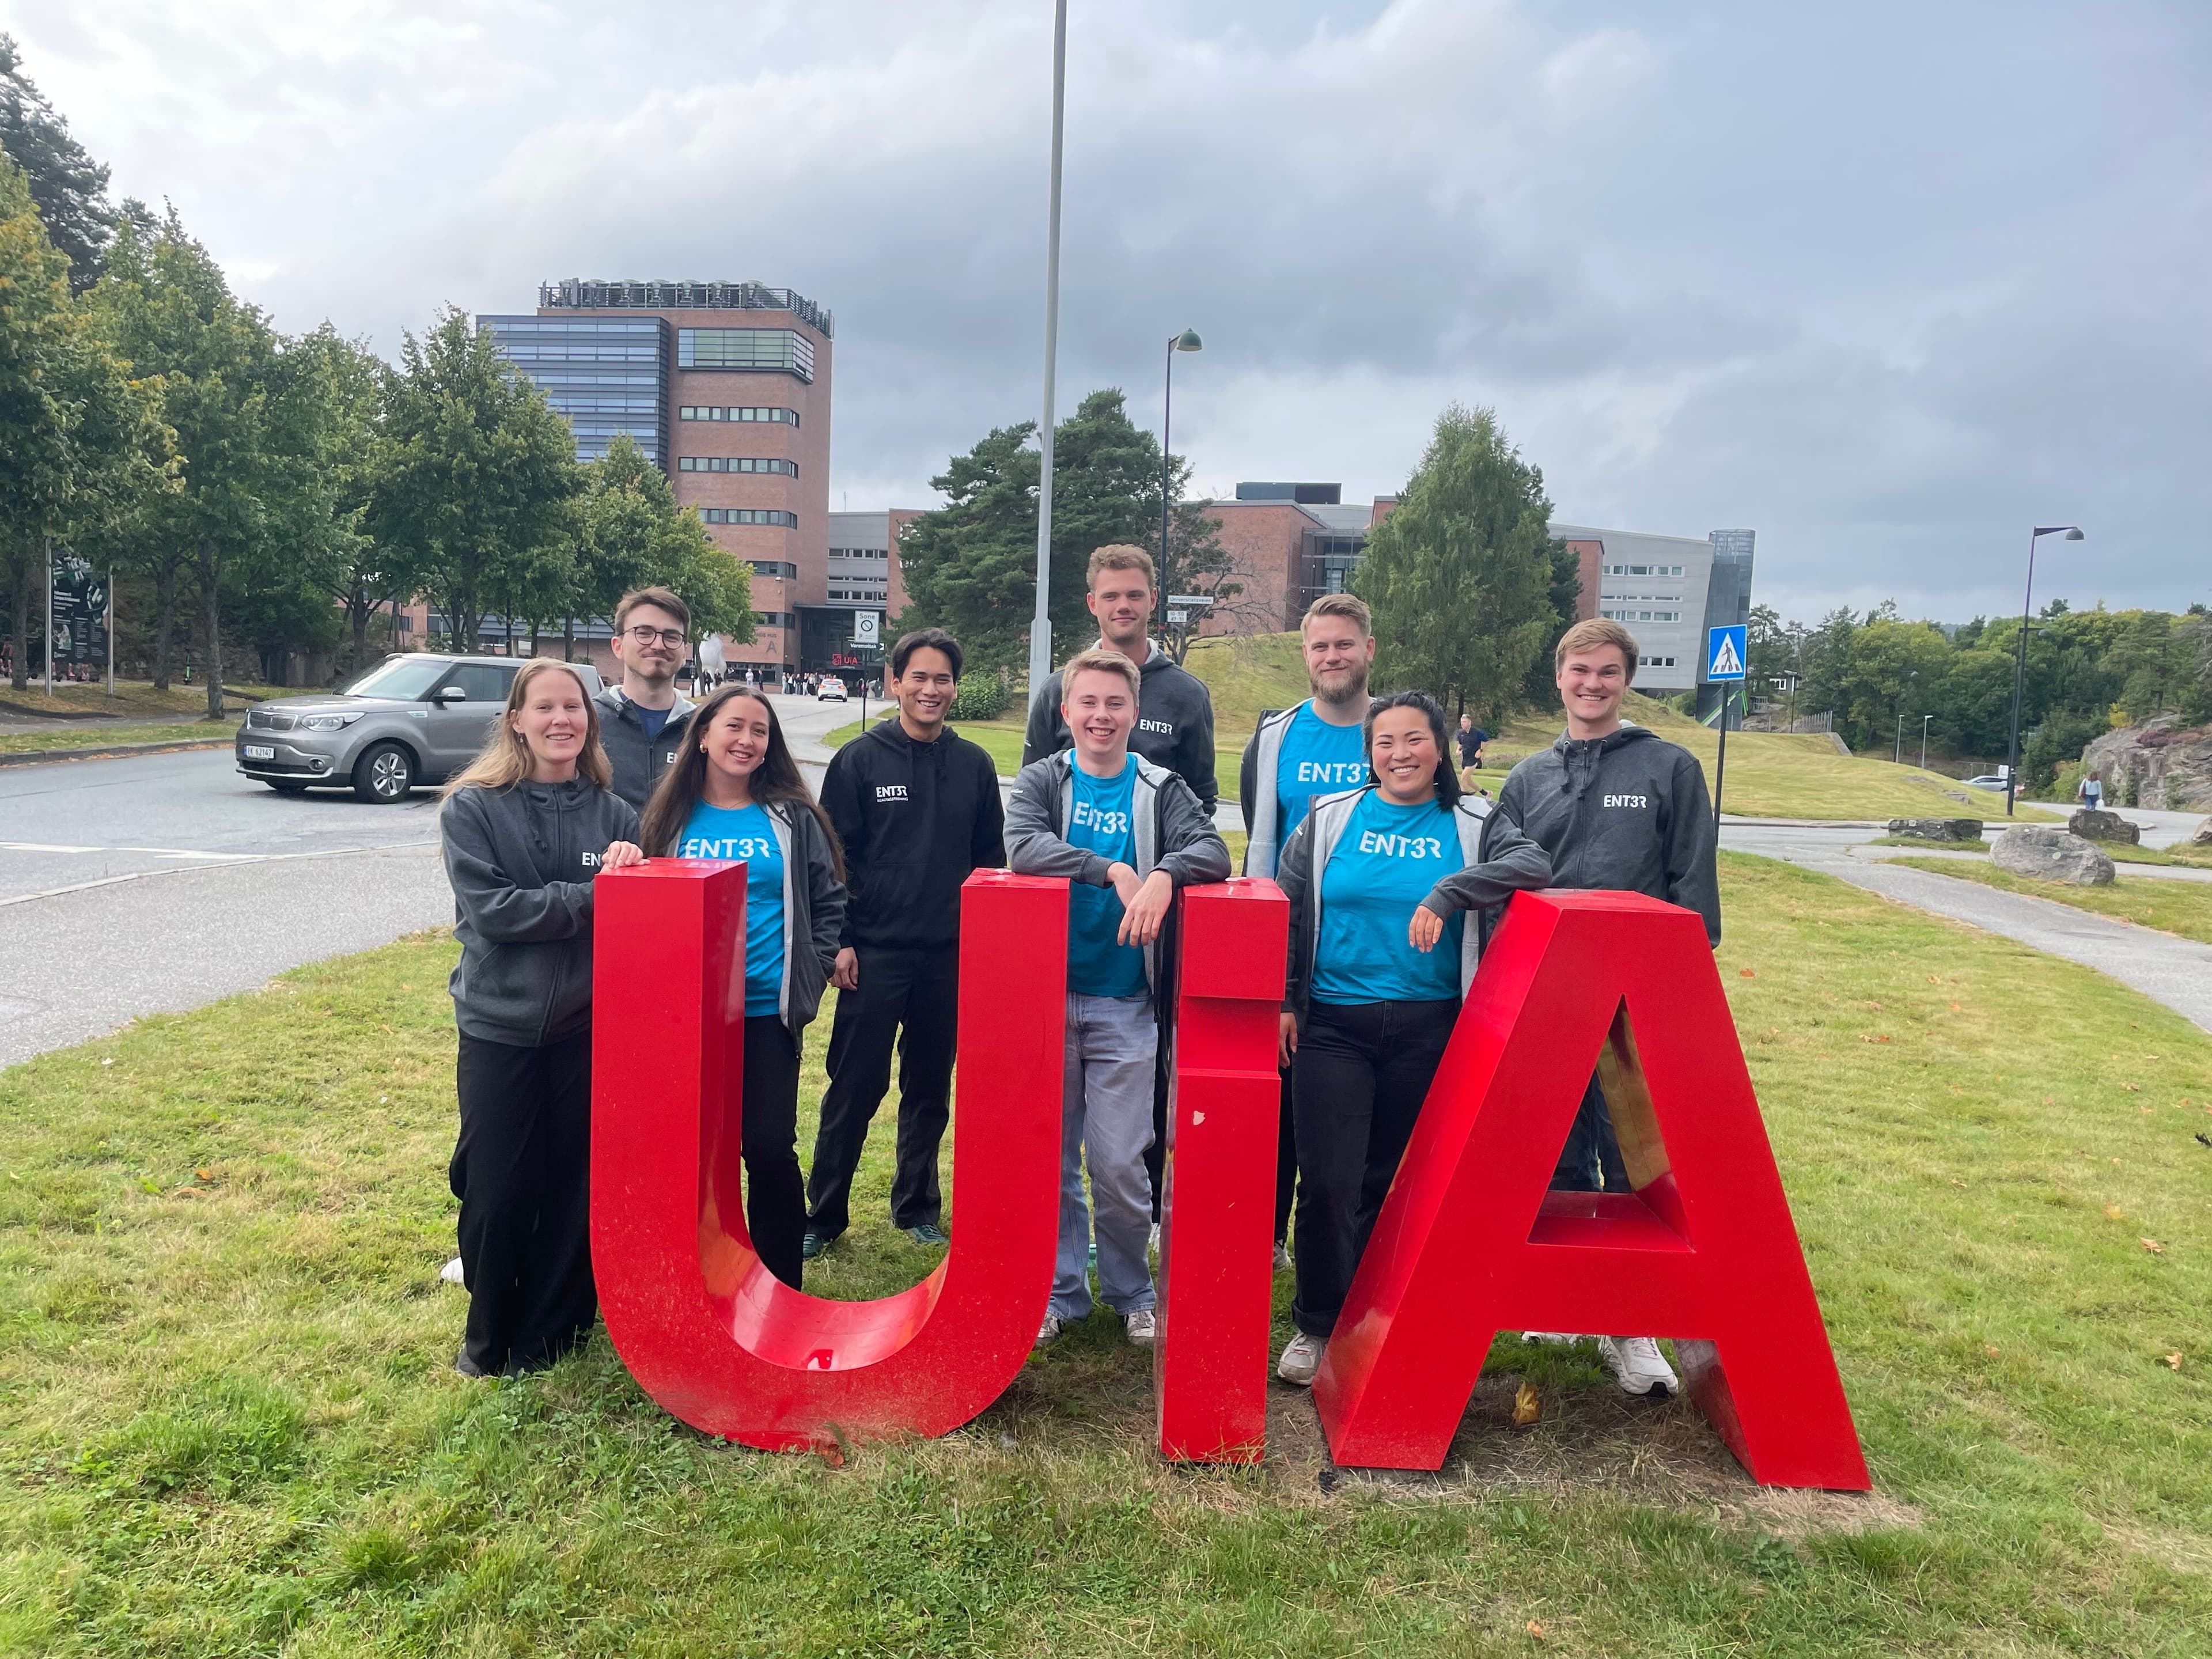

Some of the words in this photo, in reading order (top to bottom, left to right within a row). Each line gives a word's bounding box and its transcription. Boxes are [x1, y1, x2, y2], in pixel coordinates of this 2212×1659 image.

[766, 641, 777, 654] A
[1140, 718, 1173, 735] ENT3R
[876, 785, 908, 798] ENT3R
[1603, 794, 1647, 808] ENT3R
[685, 838, 771, 859] ENT3R
[1359, 830, 1442, 859] ENT3R
